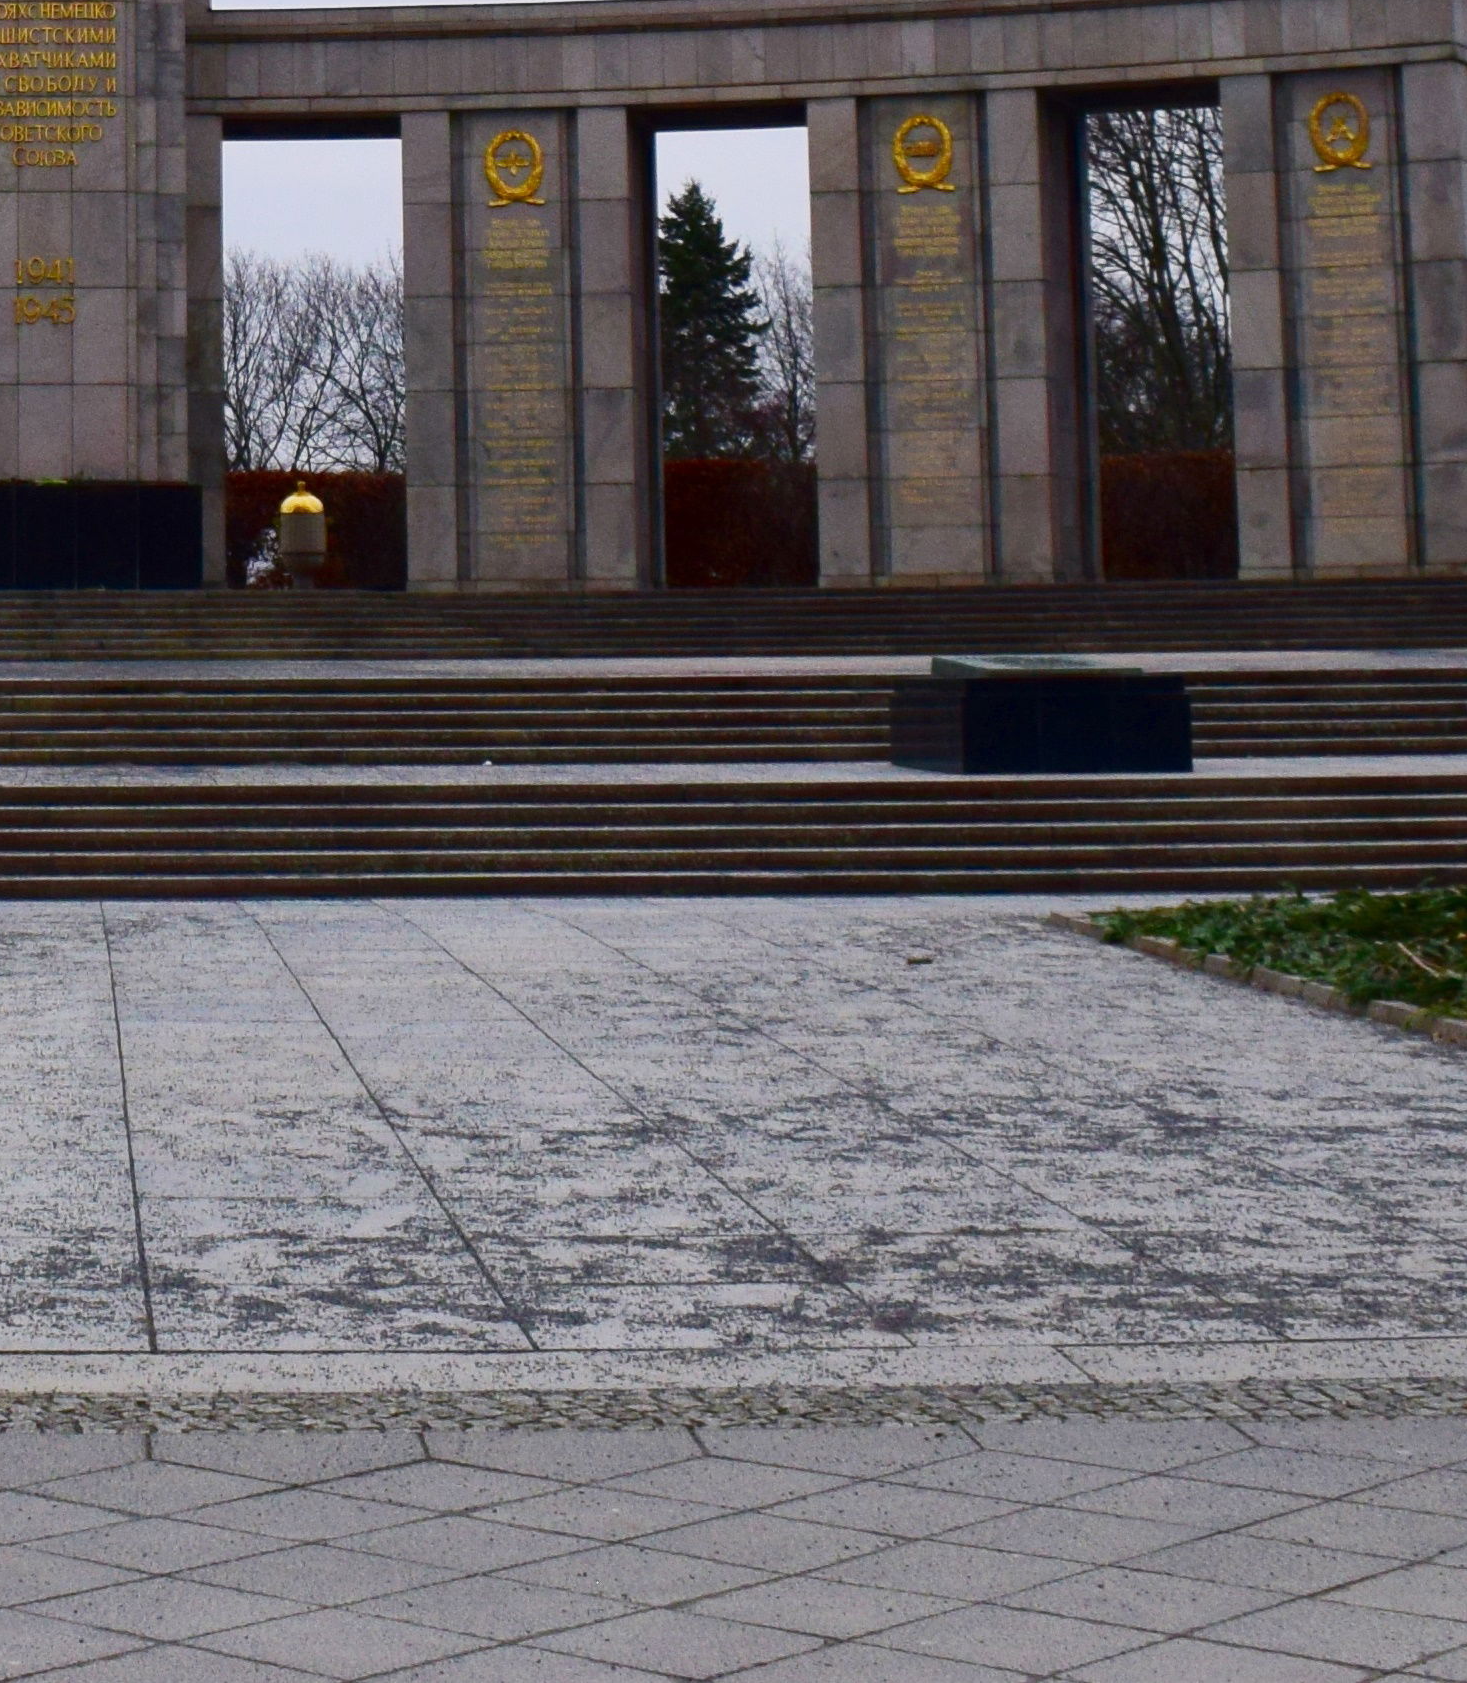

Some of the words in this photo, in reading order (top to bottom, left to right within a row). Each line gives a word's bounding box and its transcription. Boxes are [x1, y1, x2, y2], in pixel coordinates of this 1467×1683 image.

[4, 75, 98, 92] СВОБОДУ
[12, 147, 77, 166] СОЮЗА
[14, 256, 76, 285] 1941
[13, 295, 77, 325] 1945
